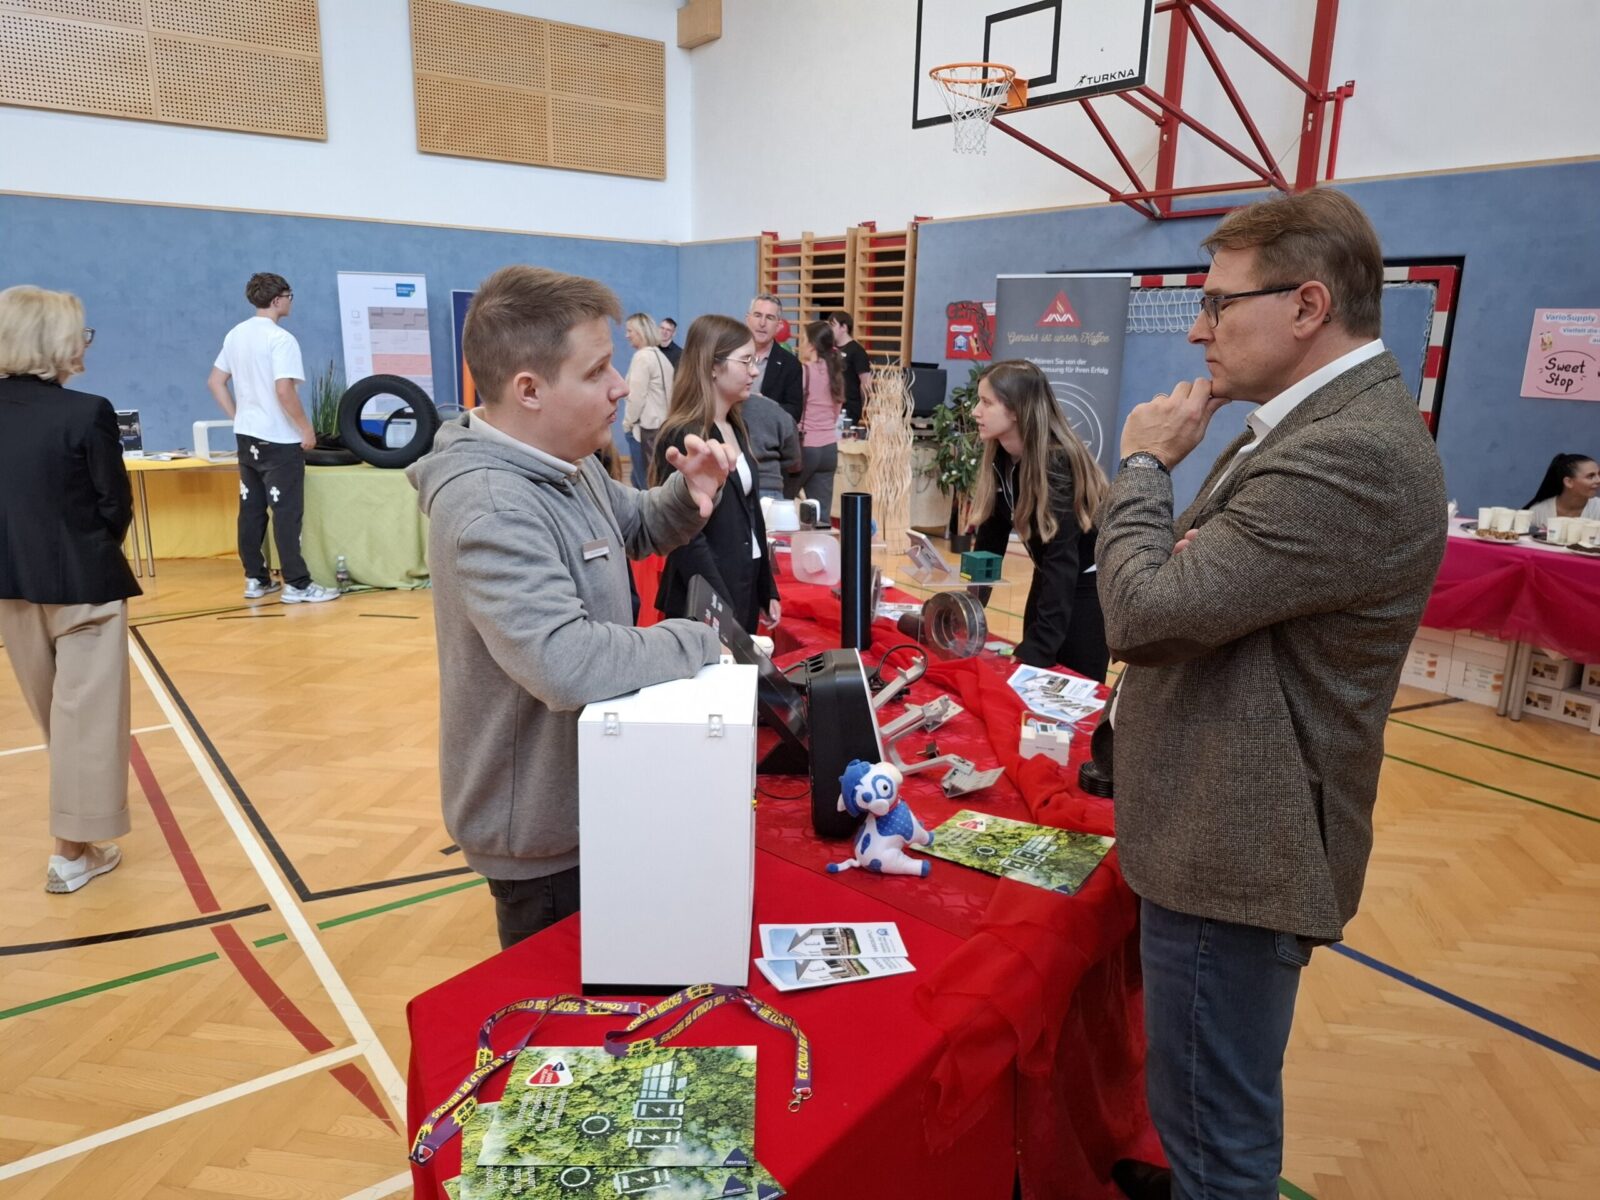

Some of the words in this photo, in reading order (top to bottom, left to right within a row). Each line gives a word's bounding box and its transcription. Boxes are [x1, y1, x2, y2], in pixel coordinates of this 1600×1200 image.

[1087, 69, 1135, 84] TURKNA
[1043, 313, 1074, 322] JAVA
[1545, 314, 1596, 322] VarioSupply
[1091, 366, 1109, 375] Erfolg
[1545, 357, 1587, 374] Sweet
[1545, 373, 1574, 392] Stop
